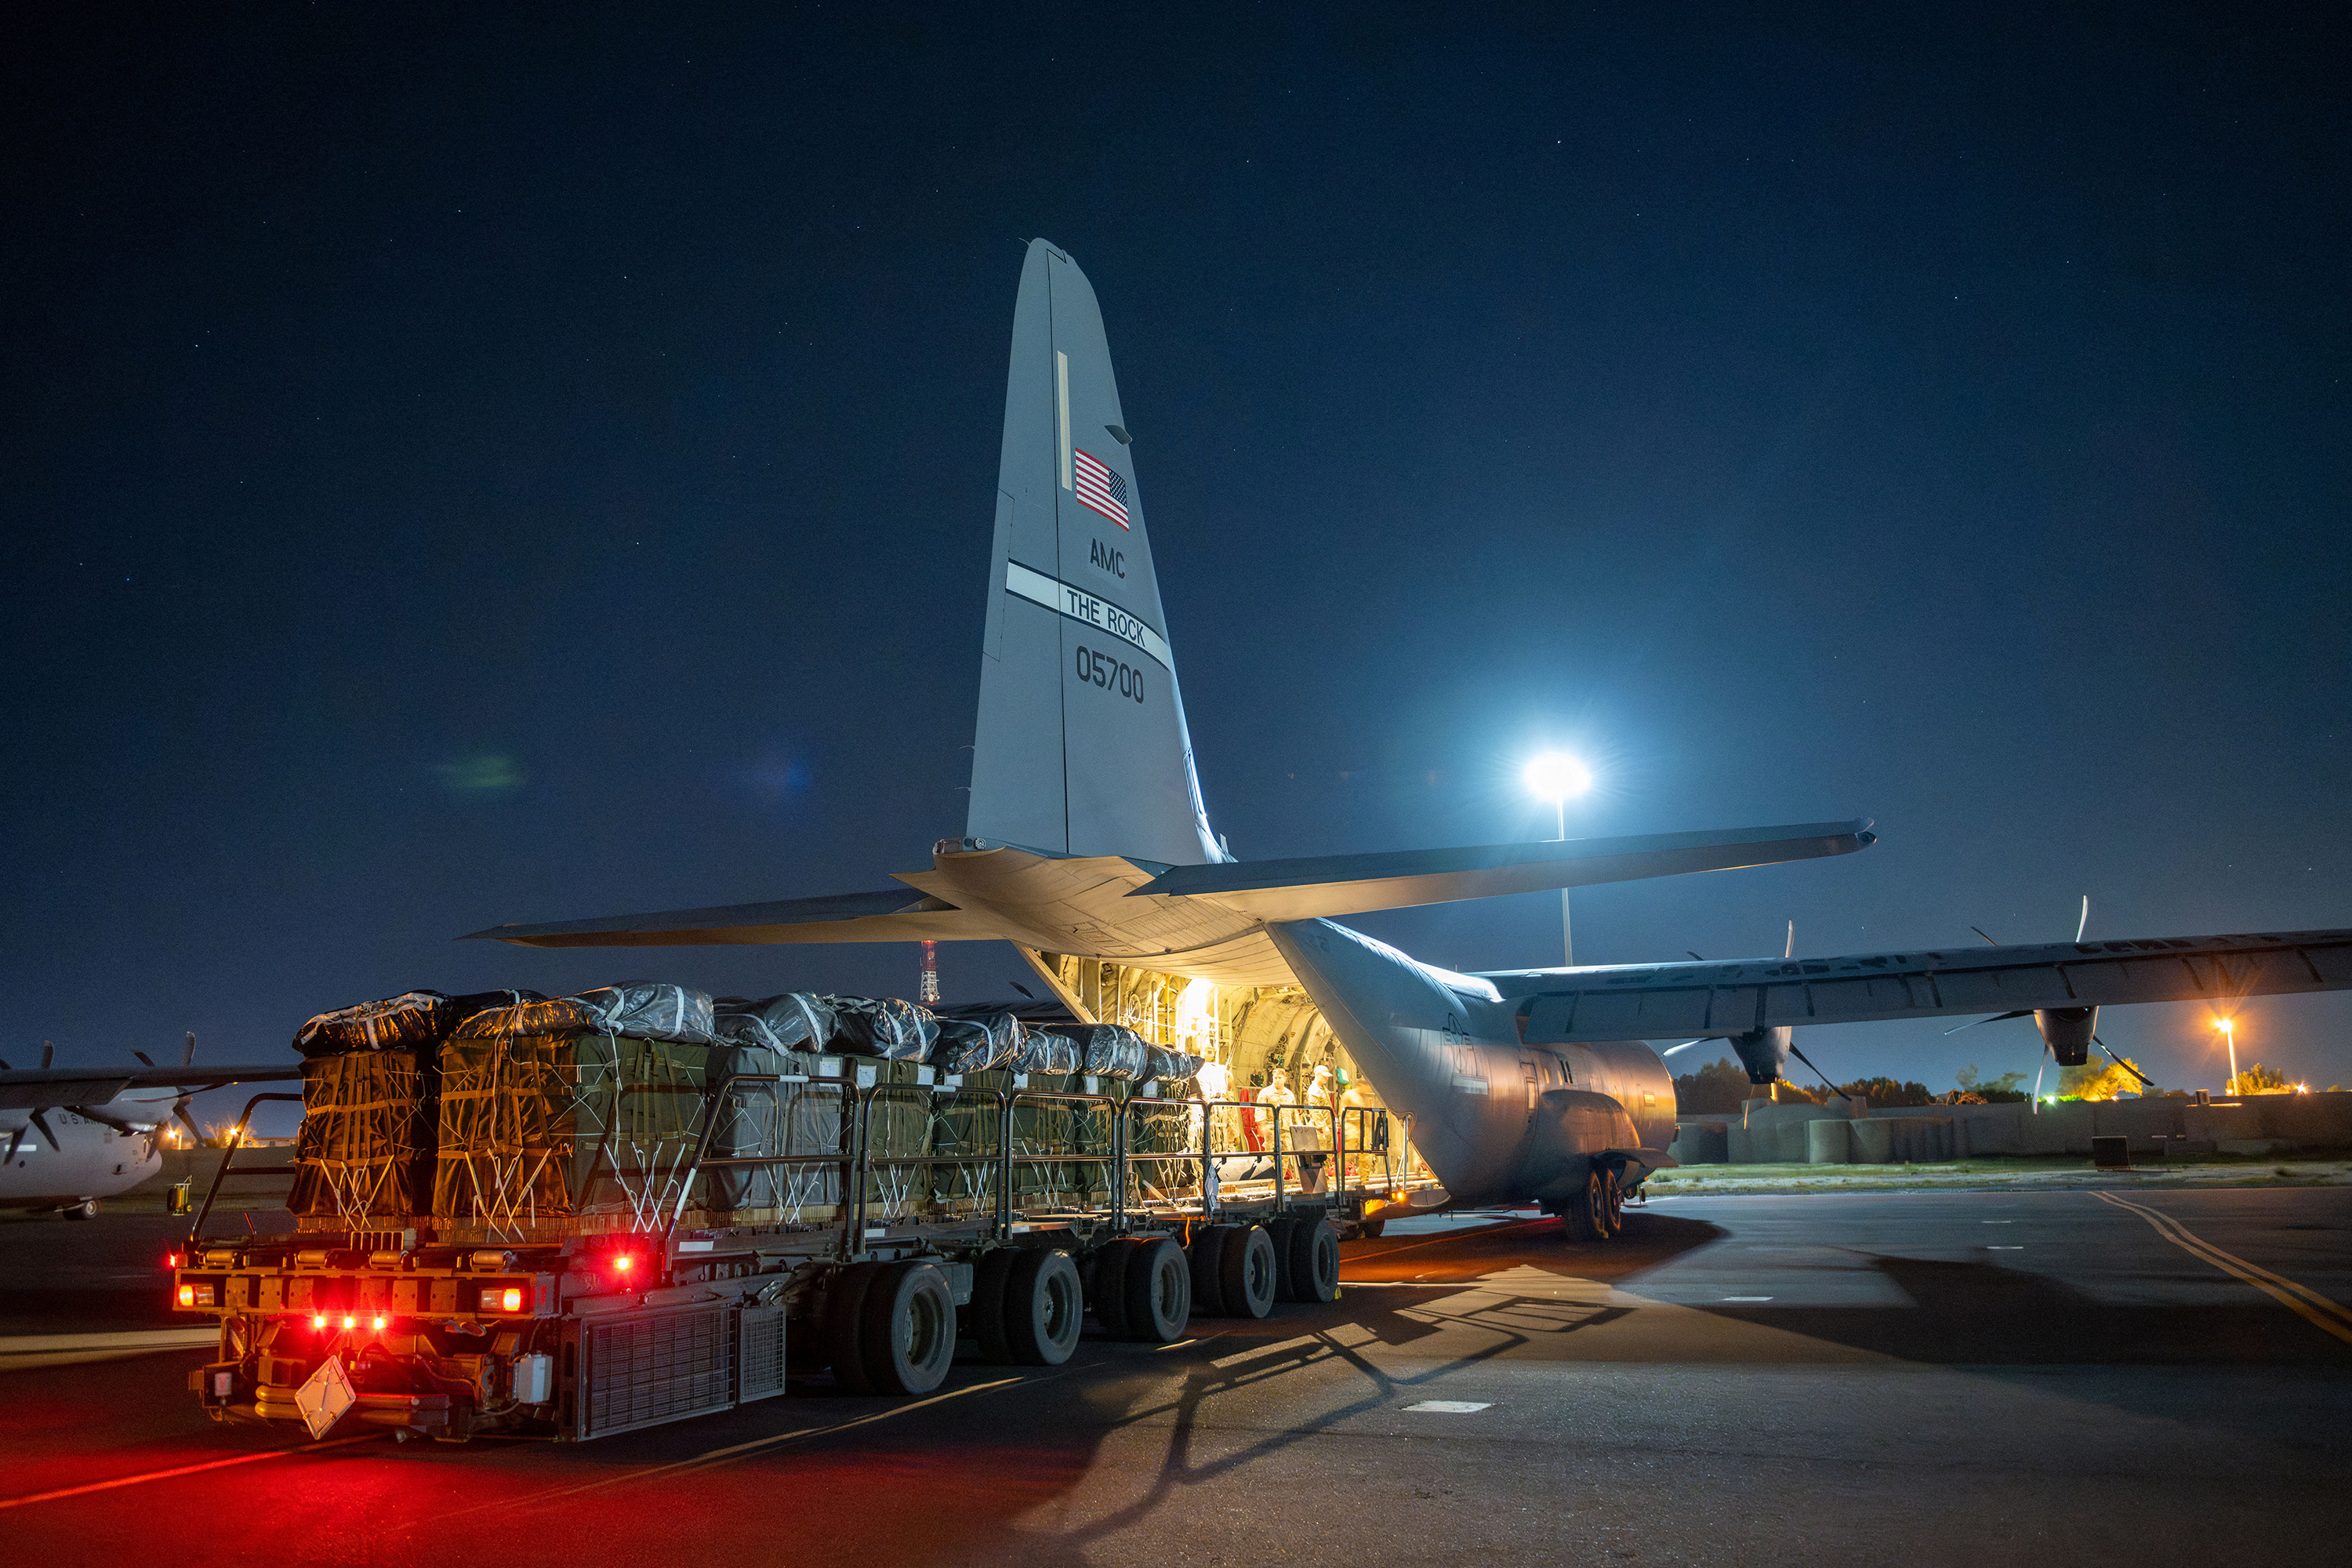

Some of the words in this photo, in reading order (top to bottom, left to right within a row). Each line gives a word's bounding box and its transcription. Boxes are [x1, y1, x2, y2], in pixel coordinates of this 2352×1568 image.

[1090, 537, 1125, 579] AMC
[1066, 589, 1101, 625] THE
[1107, 607, 1145, 648] ROCK
[1076, 645, 1145, 704] 05700
